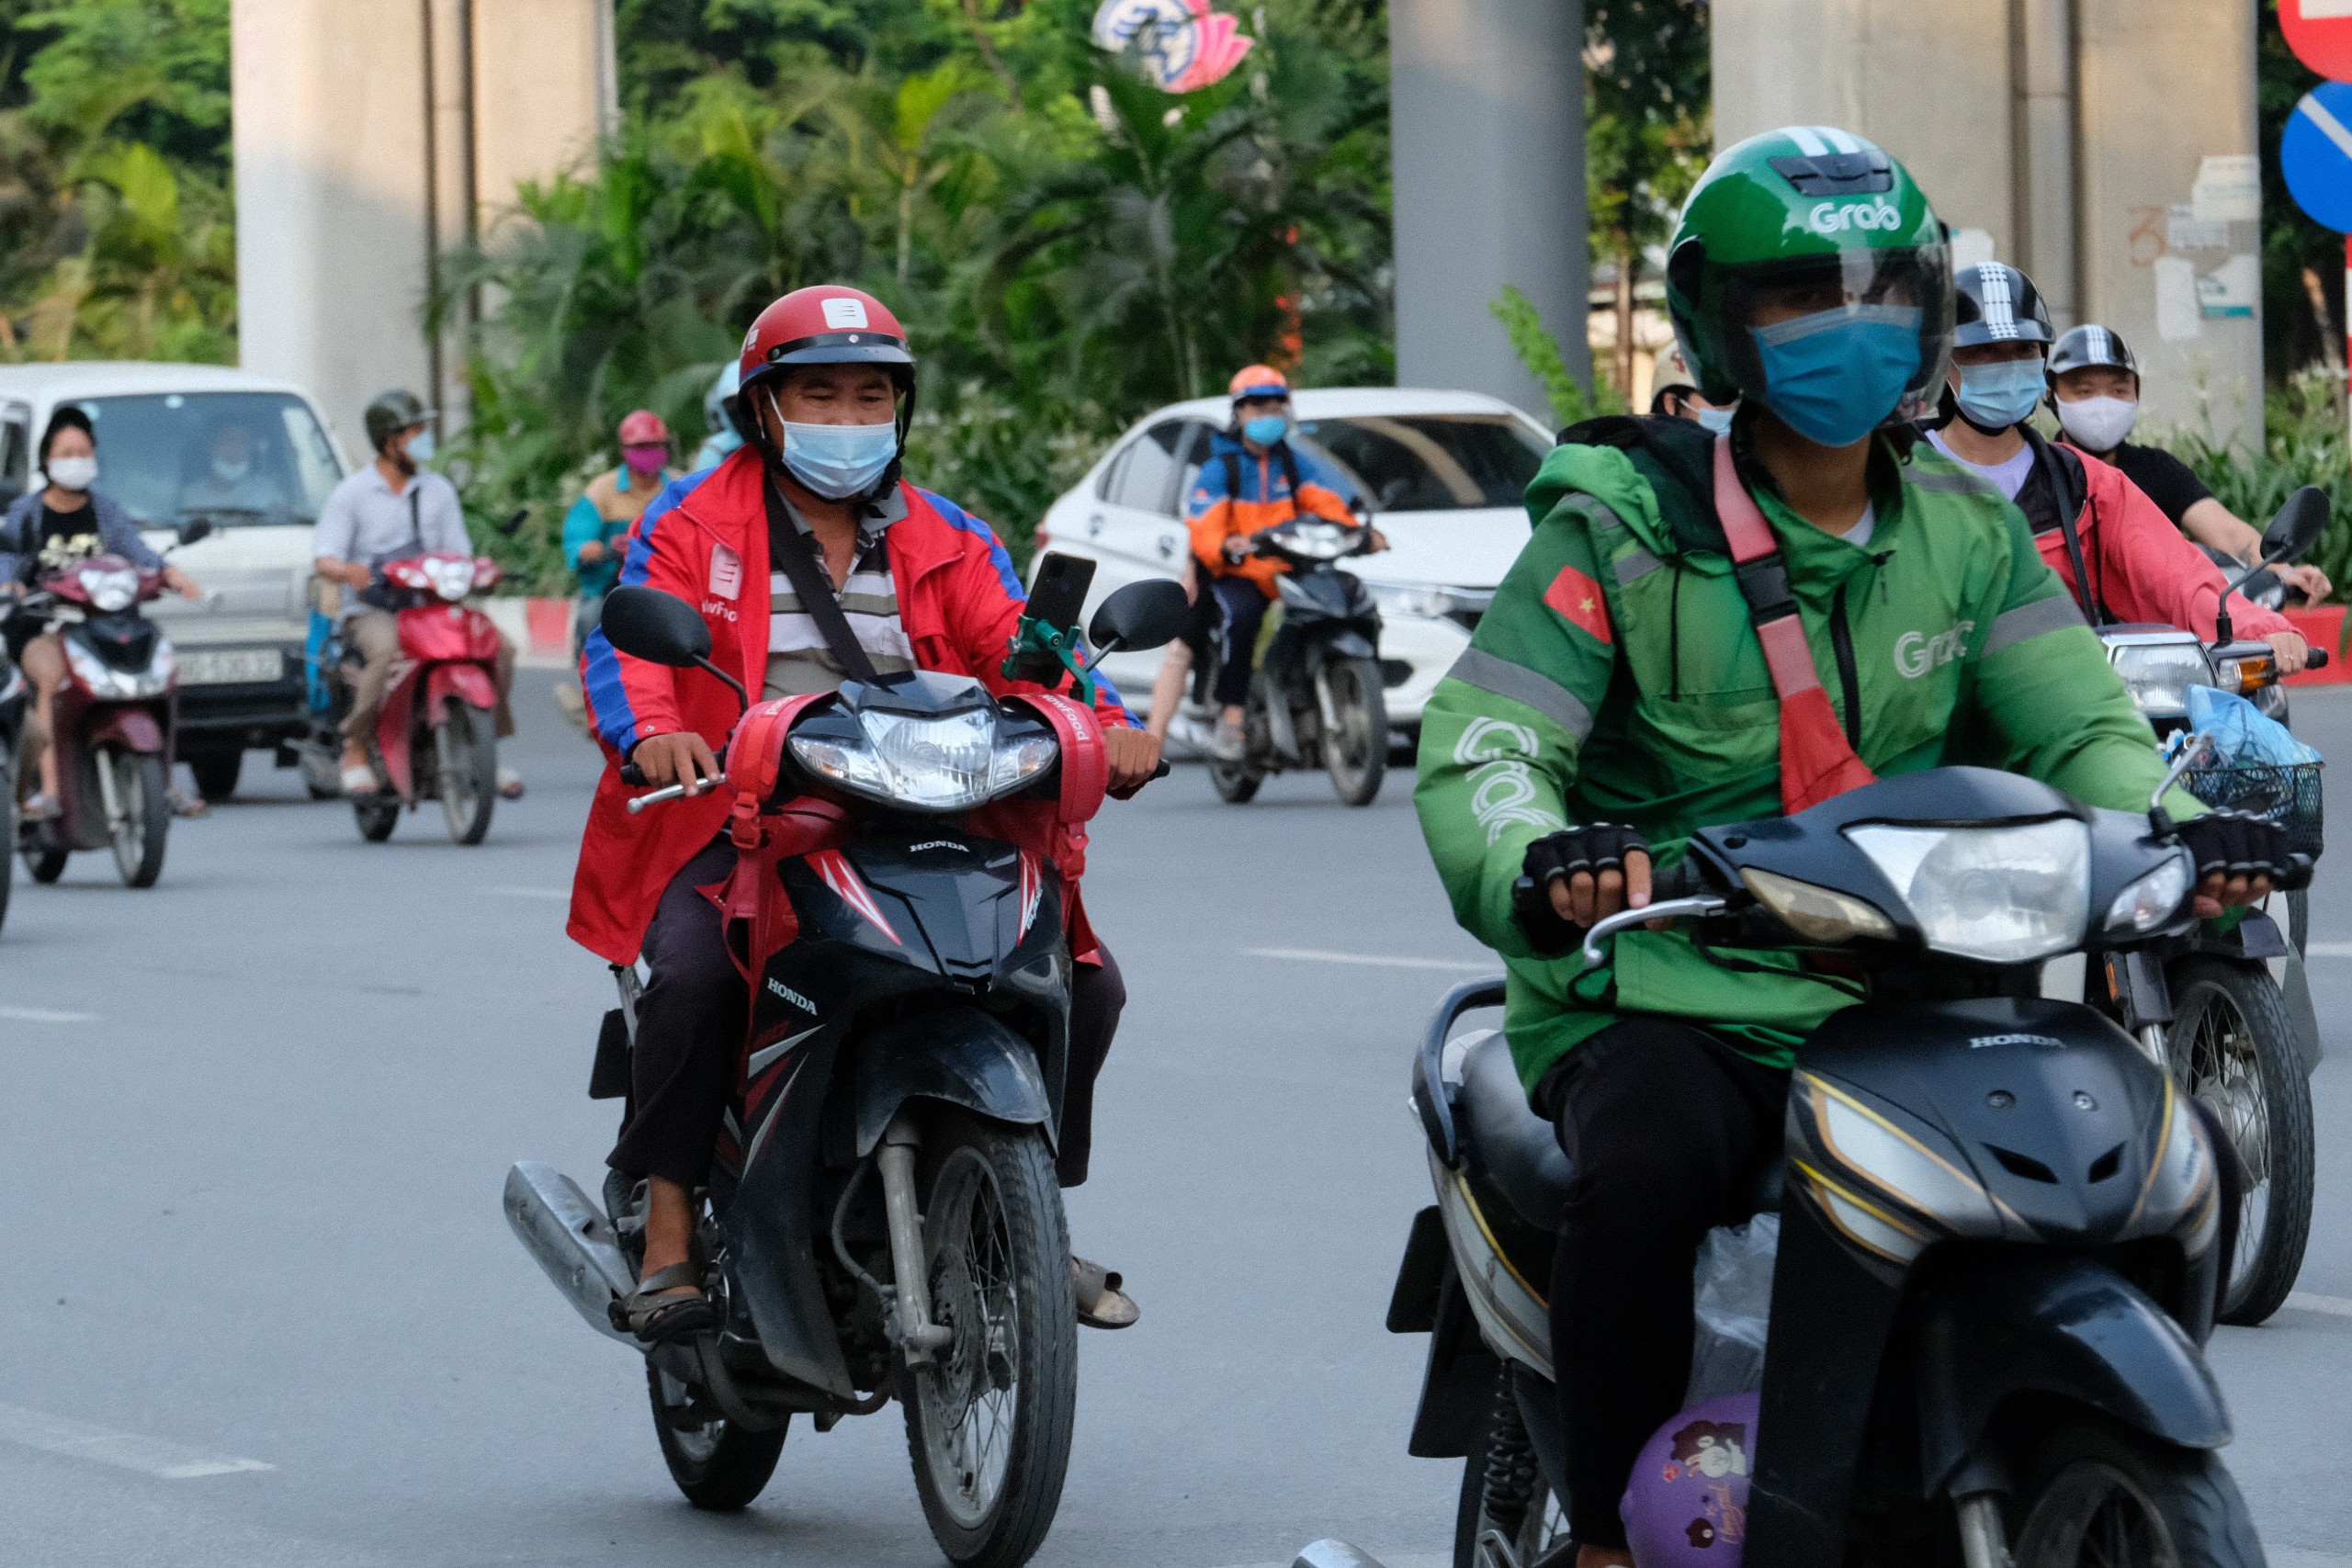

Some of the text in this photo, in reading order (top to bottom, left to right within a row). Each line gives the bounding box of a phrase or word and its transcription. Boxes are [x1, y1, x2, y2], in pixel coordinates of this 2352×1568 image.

[1809, 195, 1902, 233] Grab
[910, 840, 970, 852] HONDA
[767, 977, 818, 1016] HONDA
[1969, 1033, 2068, 1048] HONDA
